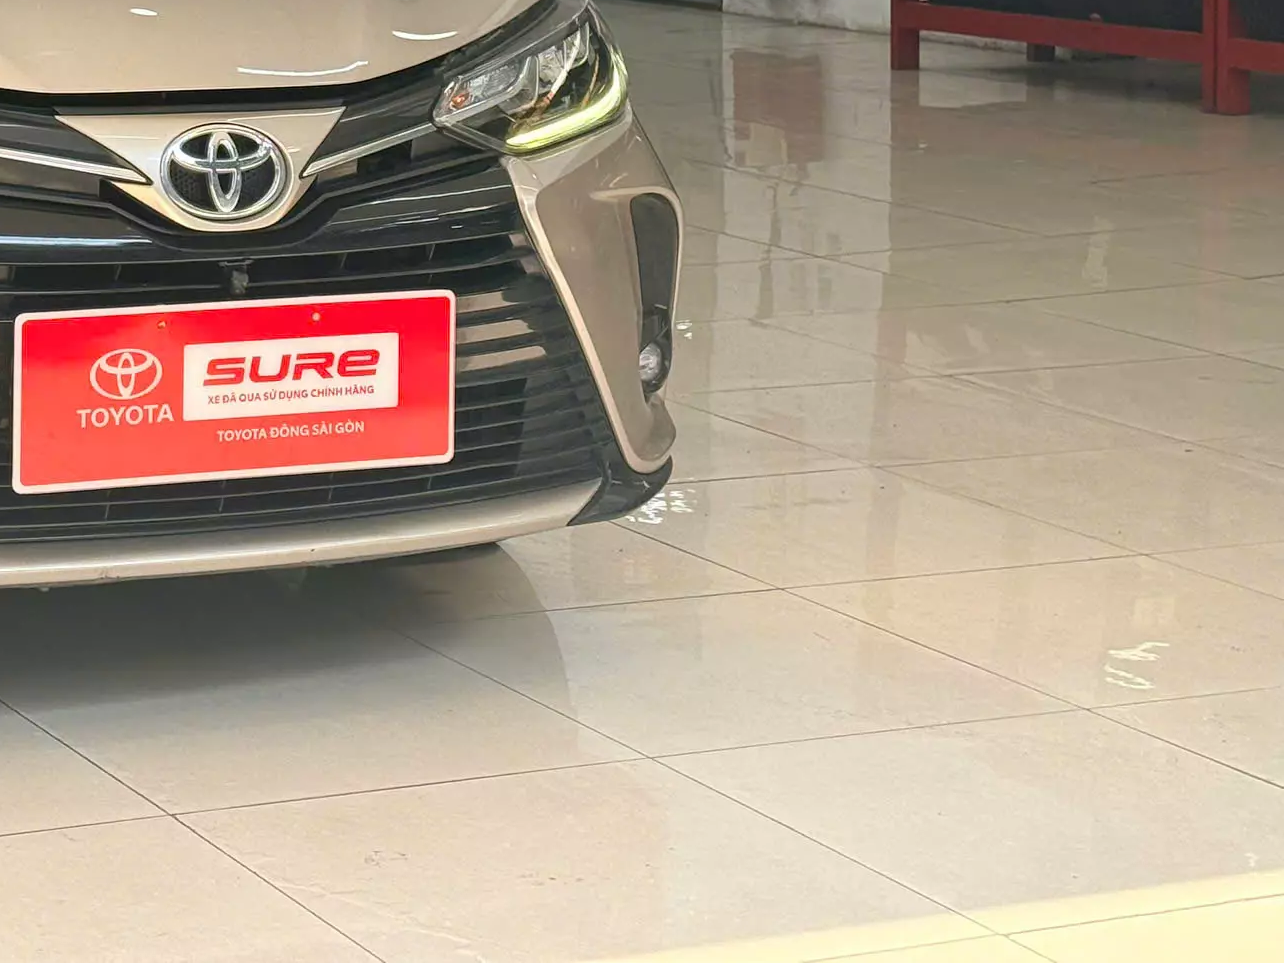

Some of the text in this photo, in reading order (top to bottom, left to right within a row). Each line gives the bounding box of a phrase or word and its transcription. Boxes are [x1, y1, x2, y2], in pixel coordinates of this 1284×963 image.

[208, 395, 221, 405] XE
[222, 391, 237, 404] ĐÃ
[238, 392, 262, 403] QUA
[278, 389, 309, 402] DỤNG
[310, 385, 344, 398] CHÍNH
[345, 384, 375, 396] HÃNG
[76, 403, 175, 429] TOYOTA
[217, 418, 366, 443] TOYOTA ĐÔNG SÀI GÒN
